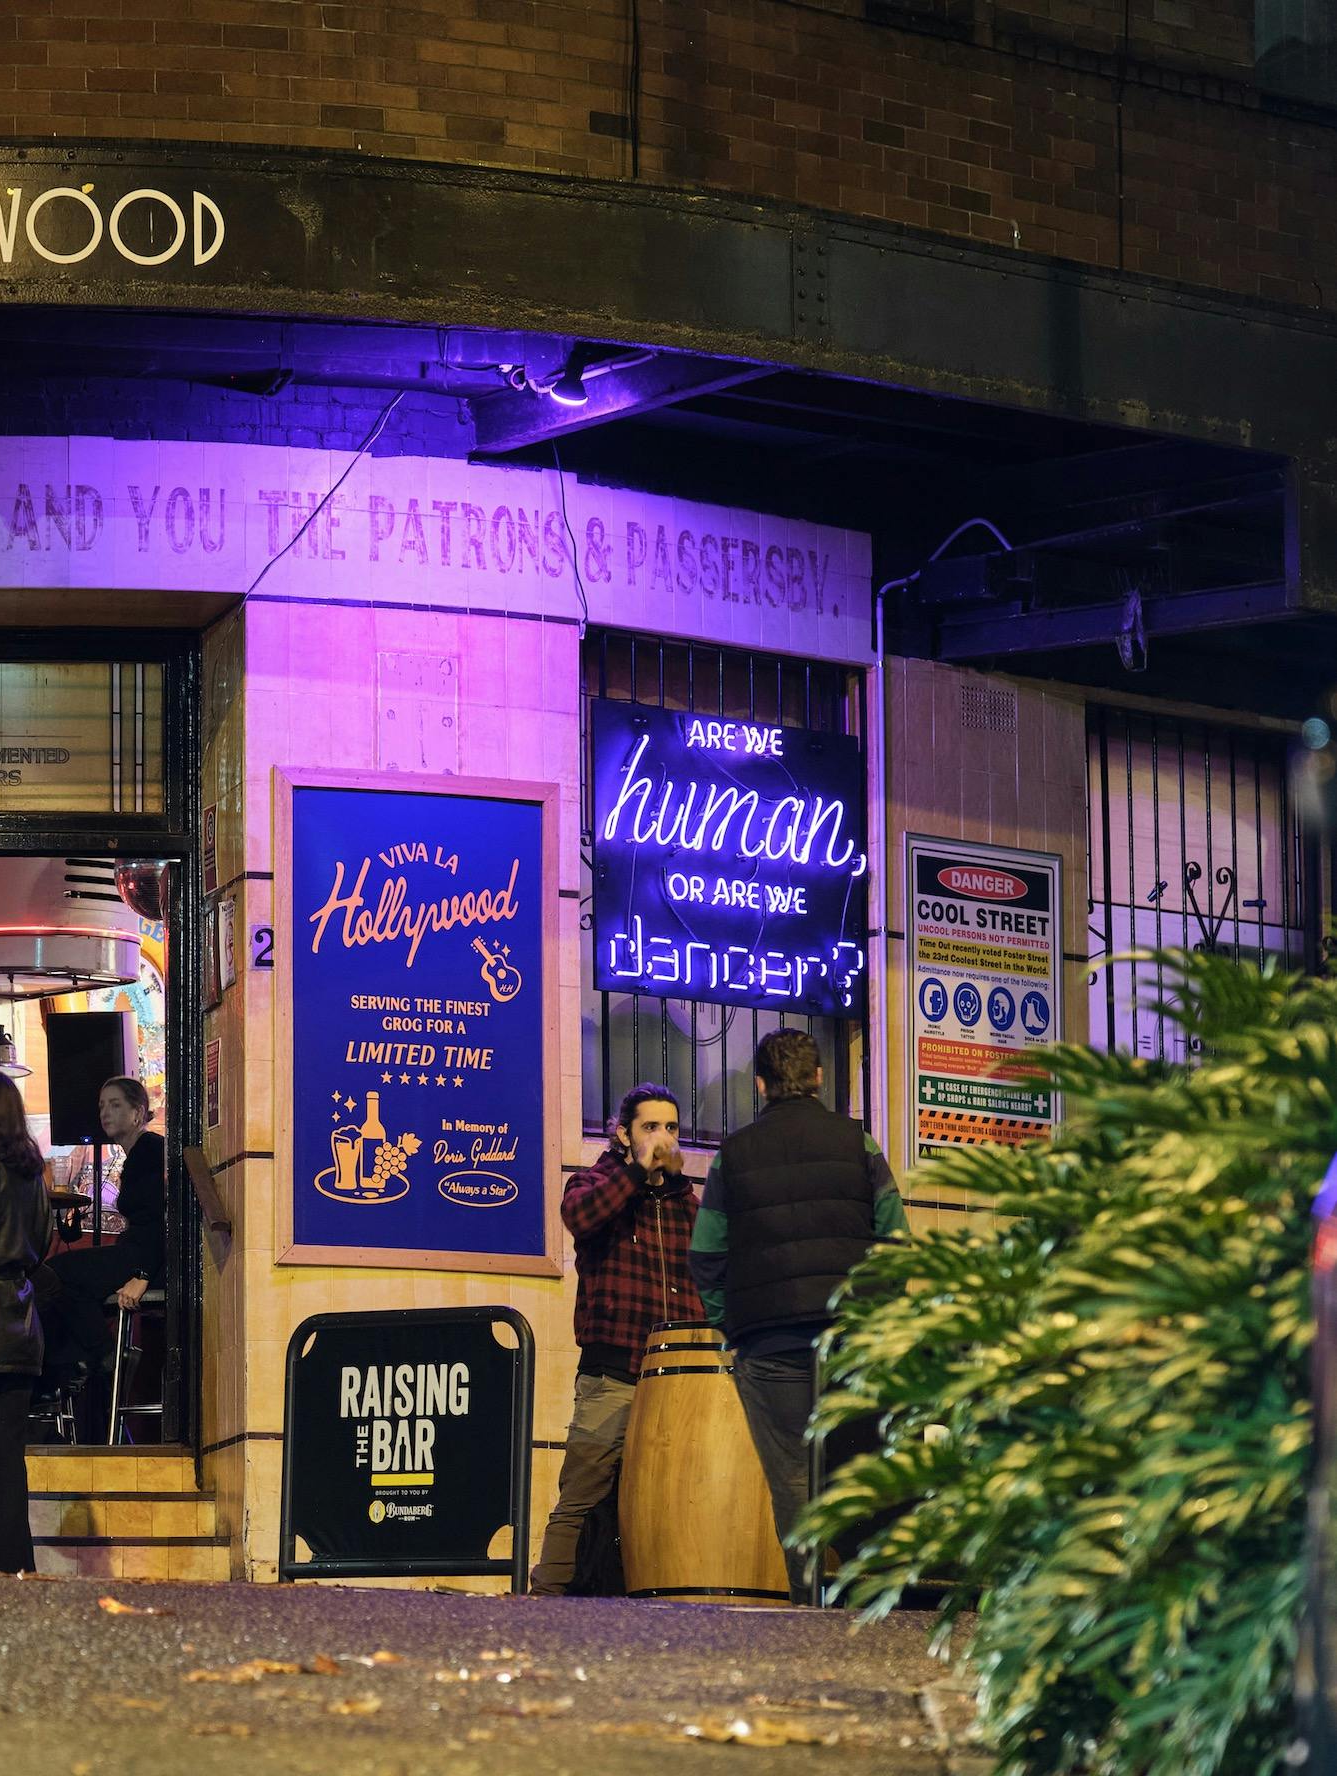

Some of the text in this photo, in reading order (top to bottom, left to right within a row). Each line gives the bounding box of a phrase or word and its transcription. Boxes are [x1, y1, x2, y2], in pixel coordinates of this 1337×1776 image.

[6, 482, 104, 554] AND
[127, 484, 226, 555] YOU
[258, 487, 347, 562] THE
[368, 495, 565, 579] PATRONS
[583, 516, 613, 585] &
[686, 719, 784, 756] ARE WE
[378, 842, 459, 876] VIVA LA
[668, 873, 808, 915] OR ARE WE
[951, 871, 1015, 896] DANGER
[309, 857, 520, 968] Hollywood
[917, 899, 1049, 936] COOL STREET
[255, 928, 274, 966] 2
[918, 924, 1050, 949] UNCOOL PERSONS NOT PERMITTED
[919, 939, 1049, 964] Time Out recently voted Foster Street
[918, 950, 930, 959] the
[932, 952, 949, 962] 23rd
[950, 954, 978, 966] Coolest
[980, 959, 1002, 969] Street
[1004, 961, 1011, 970] in
[1013, 962, 1024, 972] the
[918, 965, 951, 976] Admittance
[350, 994, 491, 1017] SERVING THE FINEST
[382, 1016, 467, 1035] GROG FOR A
[345, 1041, 494, 1071] LIMITED TIME
[921, 1042, 970, 1056] PROHIBITED
[971, 1049, 983, 1058] ON
[937, 1092, 1032, 1112] OP SHOPS & HAIR SALONS NEARBY
[945, 1082, 960, 1093] CASE
[961, 1085, 968, 1093] OF
[969, 1085, 1002, 1097] EMERGENCY
[441, 1118, 509, 1137] In Memory of
[433, 1137, 519, 1168] Doris Goddard
[340, 1362, 470, 1418] RAISING
[356, 1425, 369, 1468] THE
[371, 1418, 436, 1472] BAR
